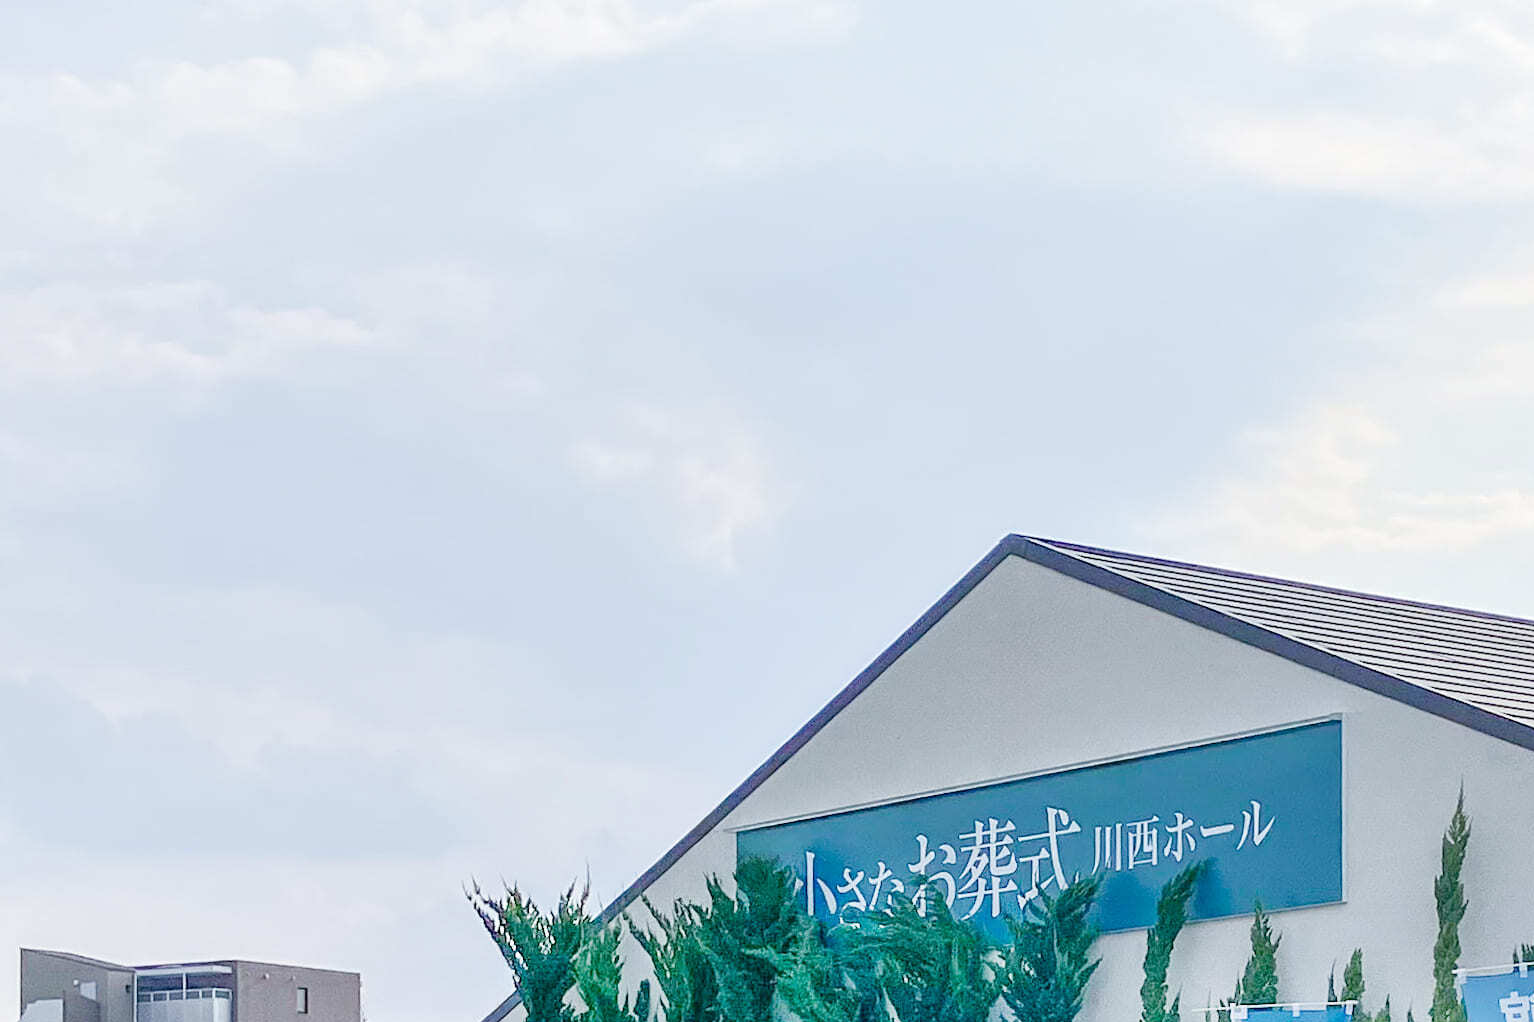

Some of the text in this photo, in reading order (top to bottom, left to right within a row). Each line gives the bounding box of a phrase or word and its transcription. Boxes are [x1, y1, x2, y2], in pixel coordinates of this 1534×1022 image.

[1091, 800, 1275, 875] 川西ホール
